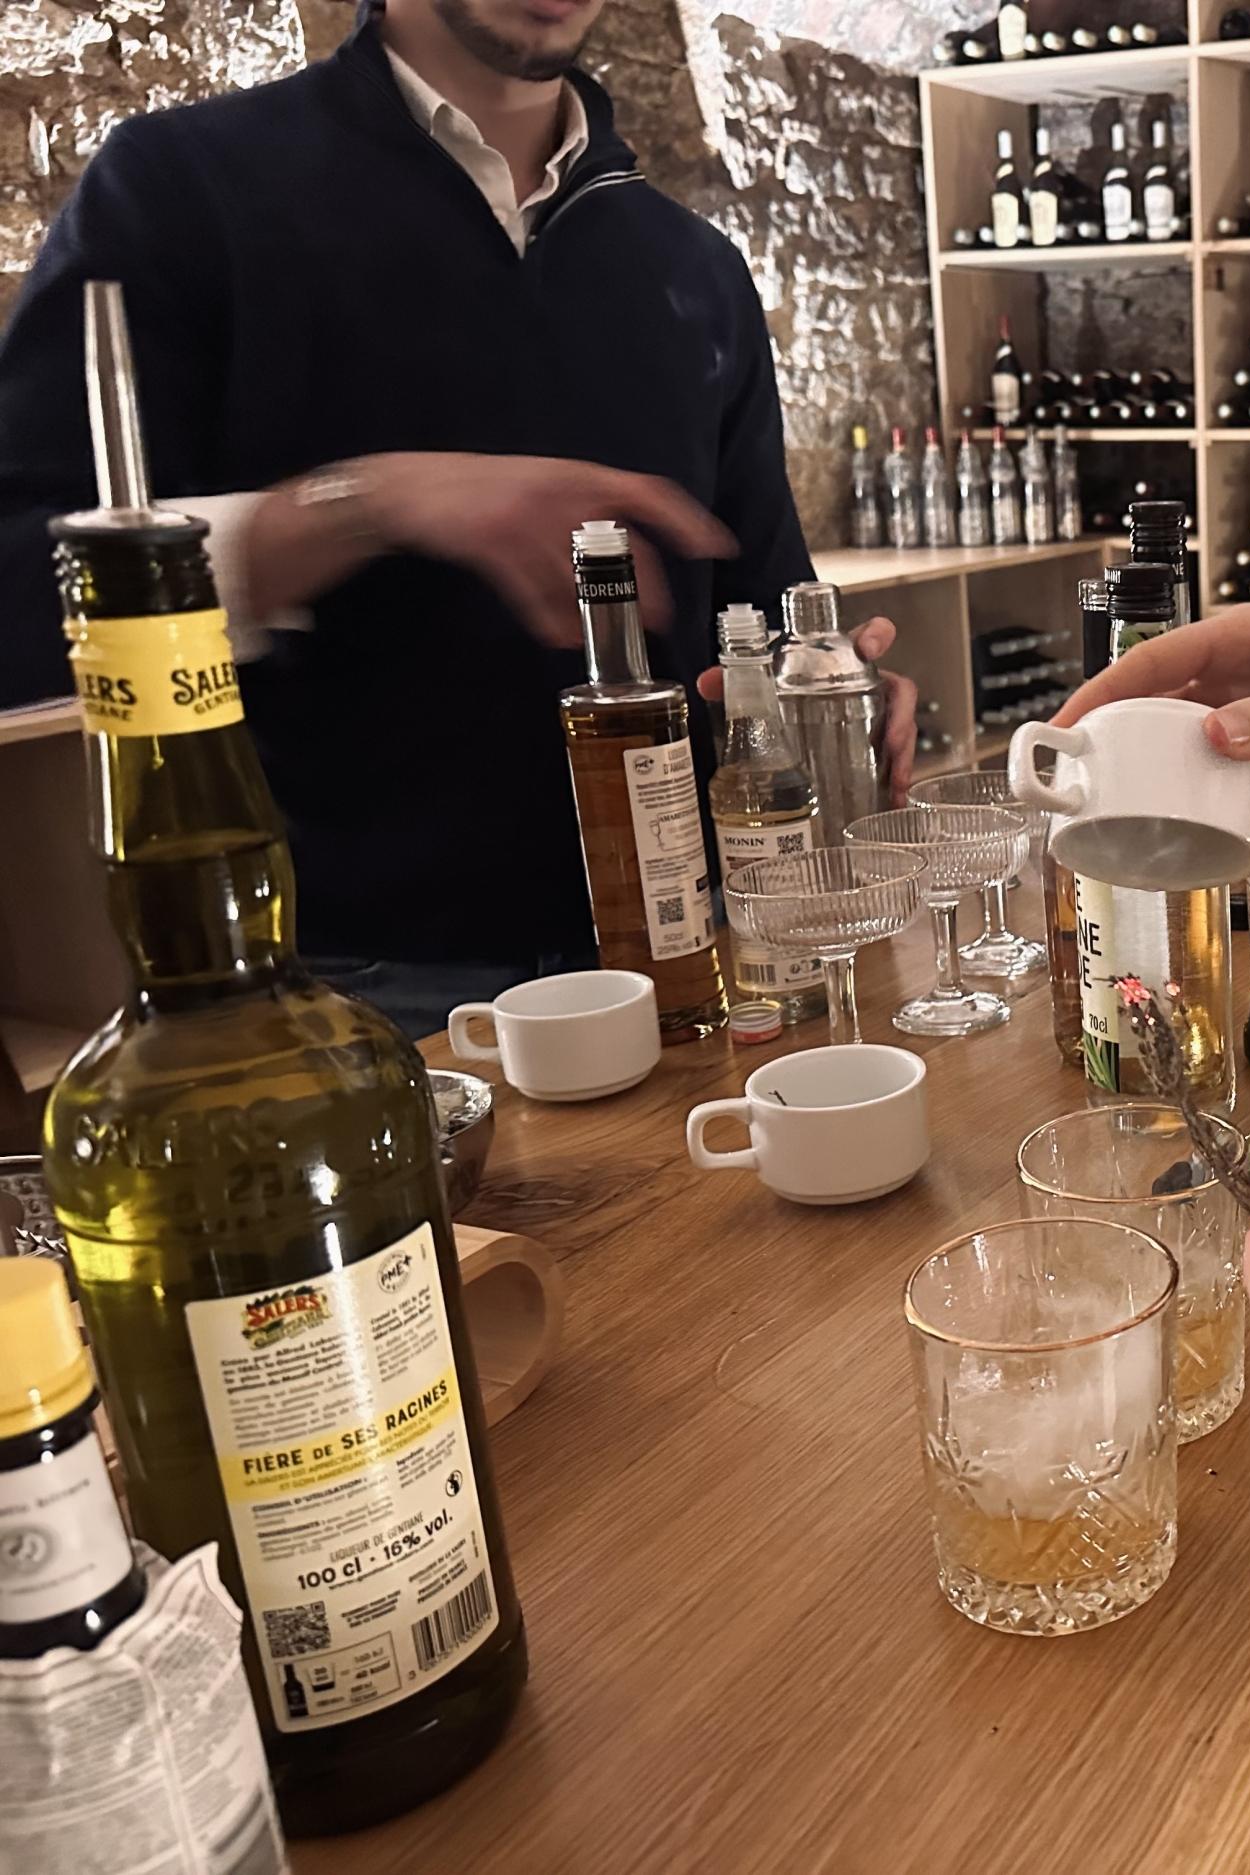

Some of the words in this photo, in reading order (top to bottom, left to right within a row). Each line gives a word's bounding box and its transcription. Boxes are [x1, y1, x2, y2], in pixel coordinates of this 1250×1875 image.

[723, 836, 765, 847] MONIN
[245, 1293, 320, 1328] SALERS
[313, 1444, 333, 1460] DE
[340, 1425, 378, 1450] SES
[385, 1379, 448, 1431] RACINES
[297, 1566, 337, 1591] 100
[342, 1557, 362, 1577] cl
[383, 1531, 421, 1560] 16%
[424, 1508, 453, 1536] vol.
[373, 1533, 384, 1547] DE
